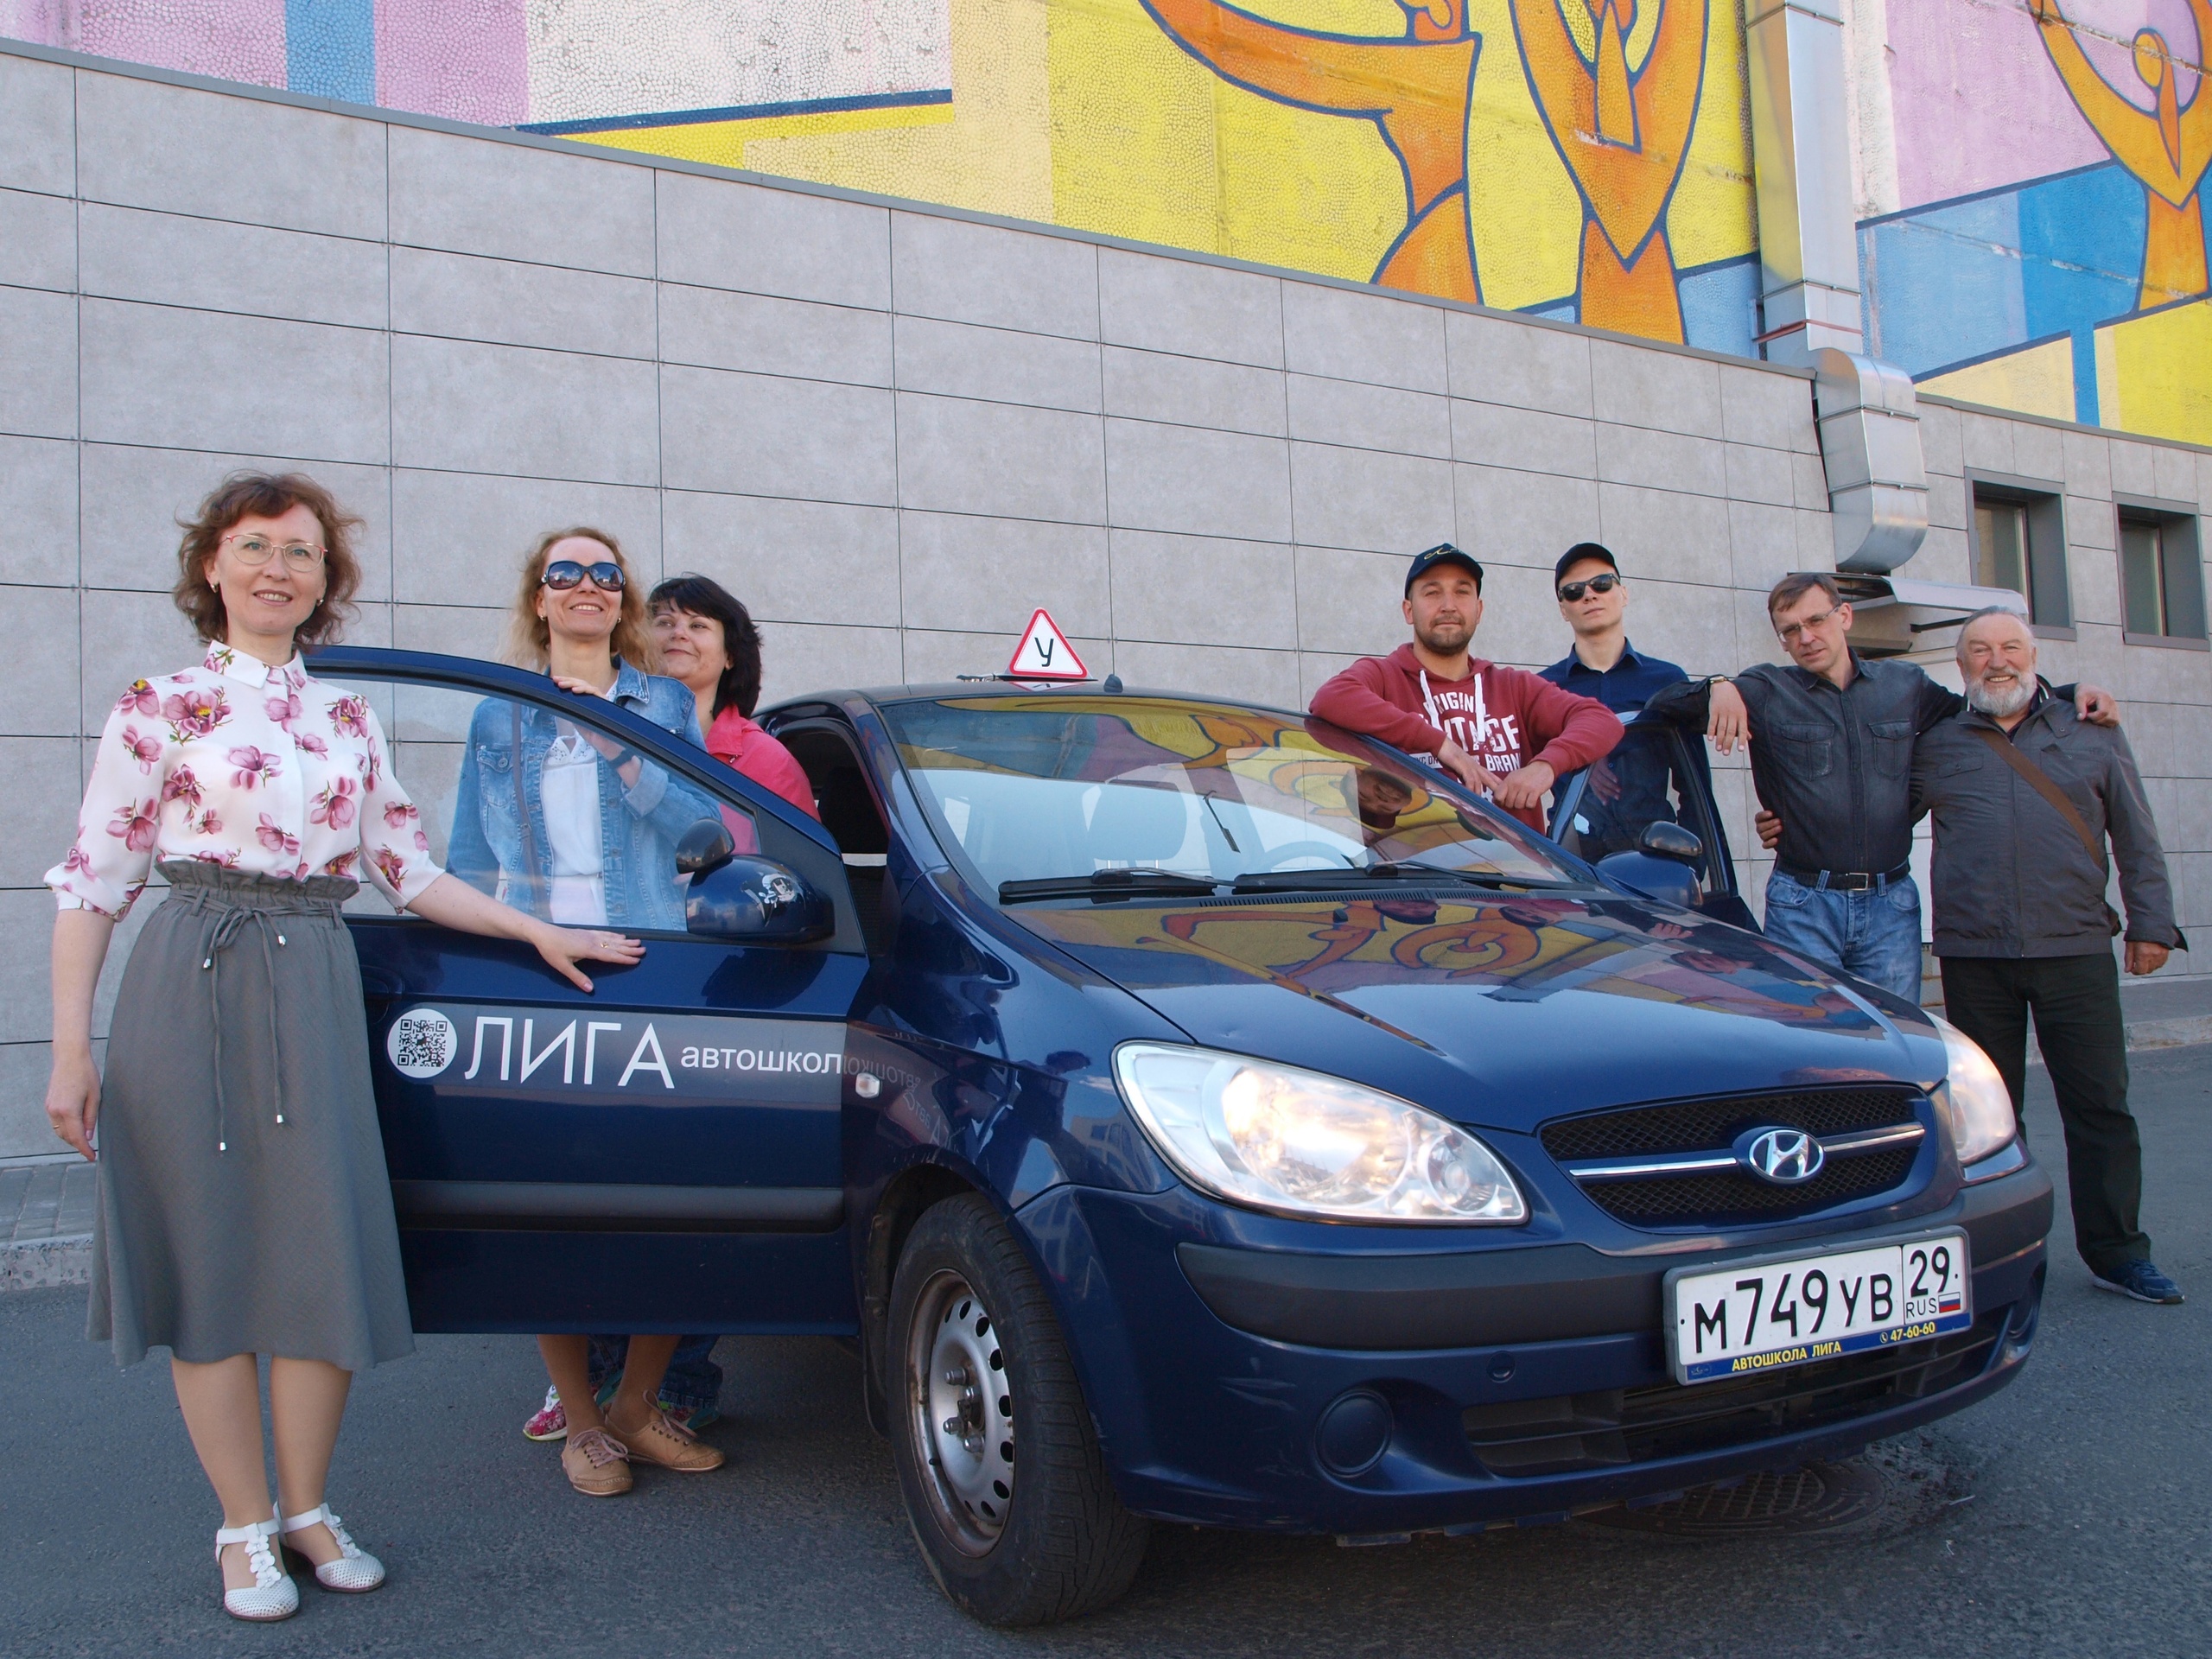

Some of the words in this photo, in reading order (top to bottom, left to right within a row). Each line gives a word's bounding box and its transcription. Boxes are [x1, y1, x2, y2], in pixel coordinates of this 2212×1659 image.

[1034, 637, 1054, 667] У
[1423, 691, 1491, 716] RIGIN
[1484, 753, 1520, 772] BRAN
[464, 1016, 675, 1089] ЛИГА
[680, 1046, 842, 1074] автошкол
[1910, 1246, 1949, 1298] 29
[1906, 1297, 1936, 1319] RUS
[1732, 1347, 1808, 1371] АВТОШКОЛА
[1812, 1341, 1841, 1357] ЛИГА
[1890, 1321, 1936, 1342] 47-60-60
